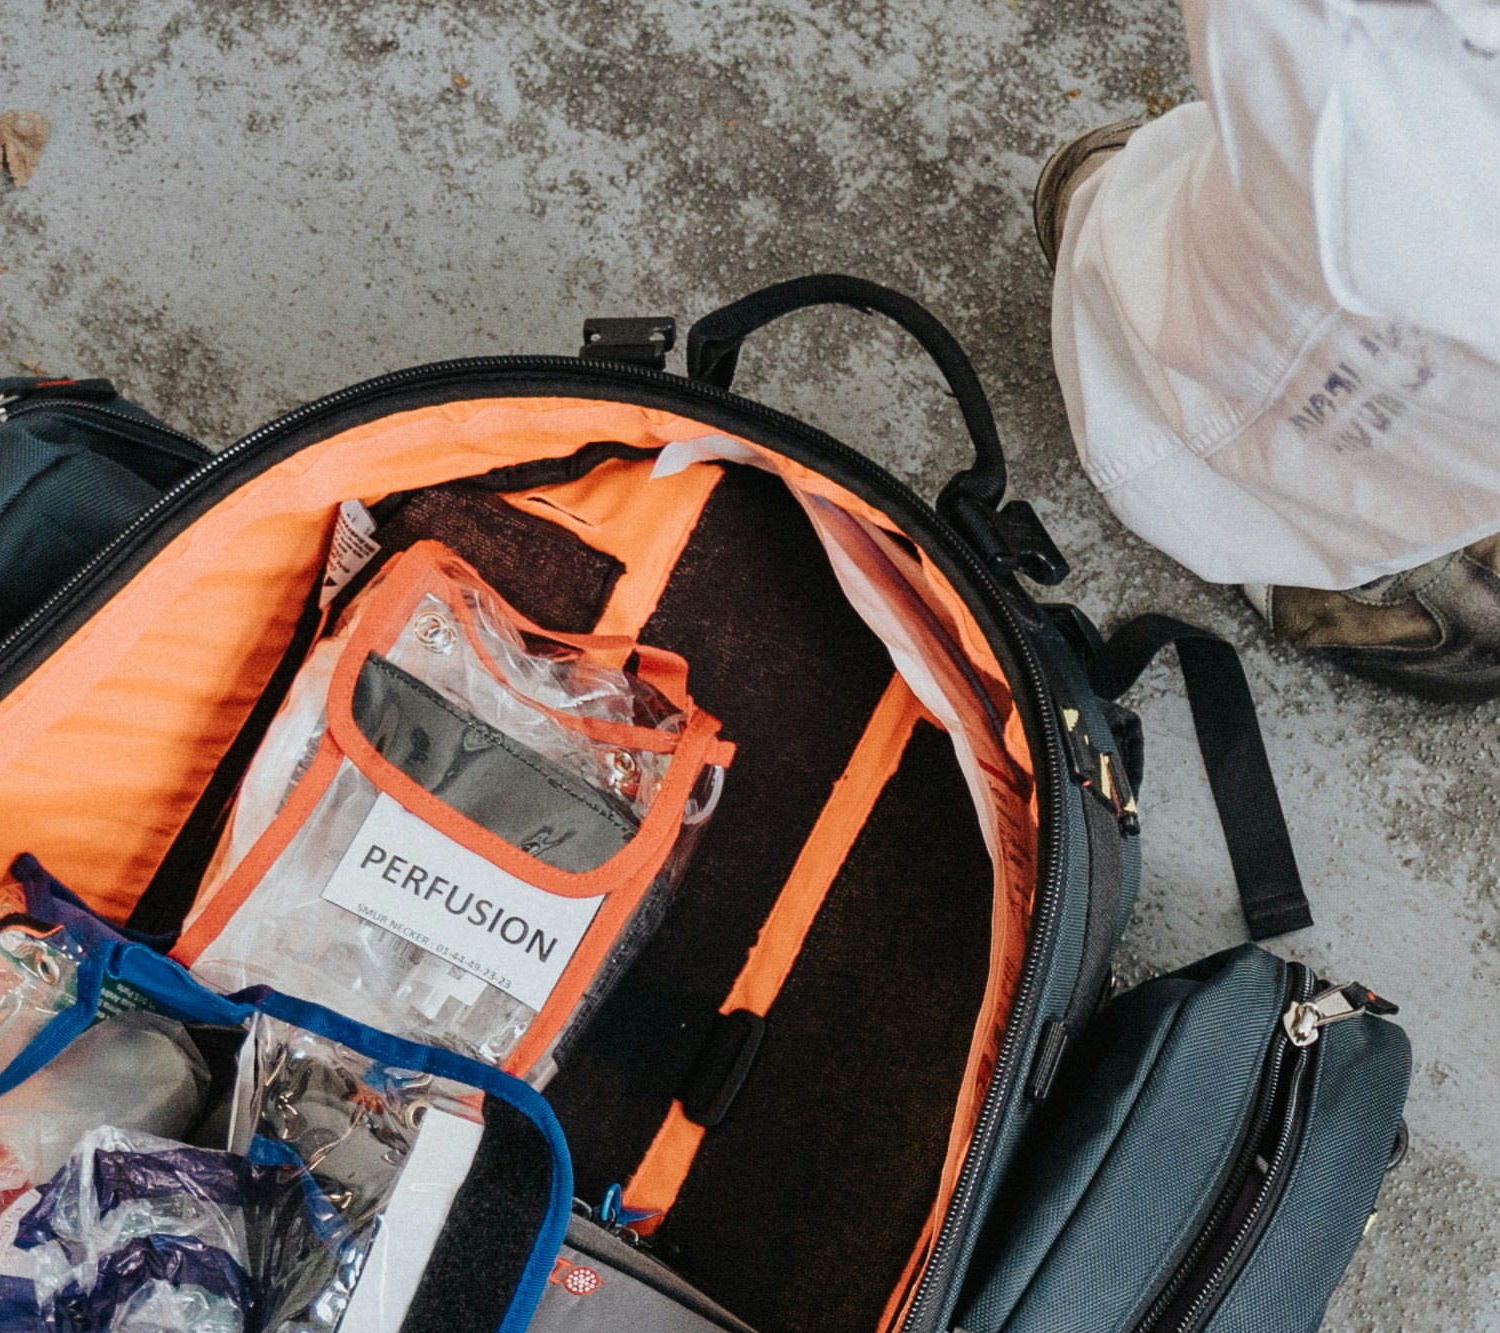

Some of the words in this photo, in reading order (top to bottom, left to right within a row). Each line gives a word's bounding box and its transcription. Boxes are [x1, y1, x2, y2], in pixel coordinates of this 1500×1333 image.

[355, 902, 388, 925] SMUR
[388, 919, 431, 947] NECKER
[434, 943, 513, 990] 01-44-49-23-23
[359, 839, 560, 966] PERFUSION
[115, 982, 135, 997] Paris
